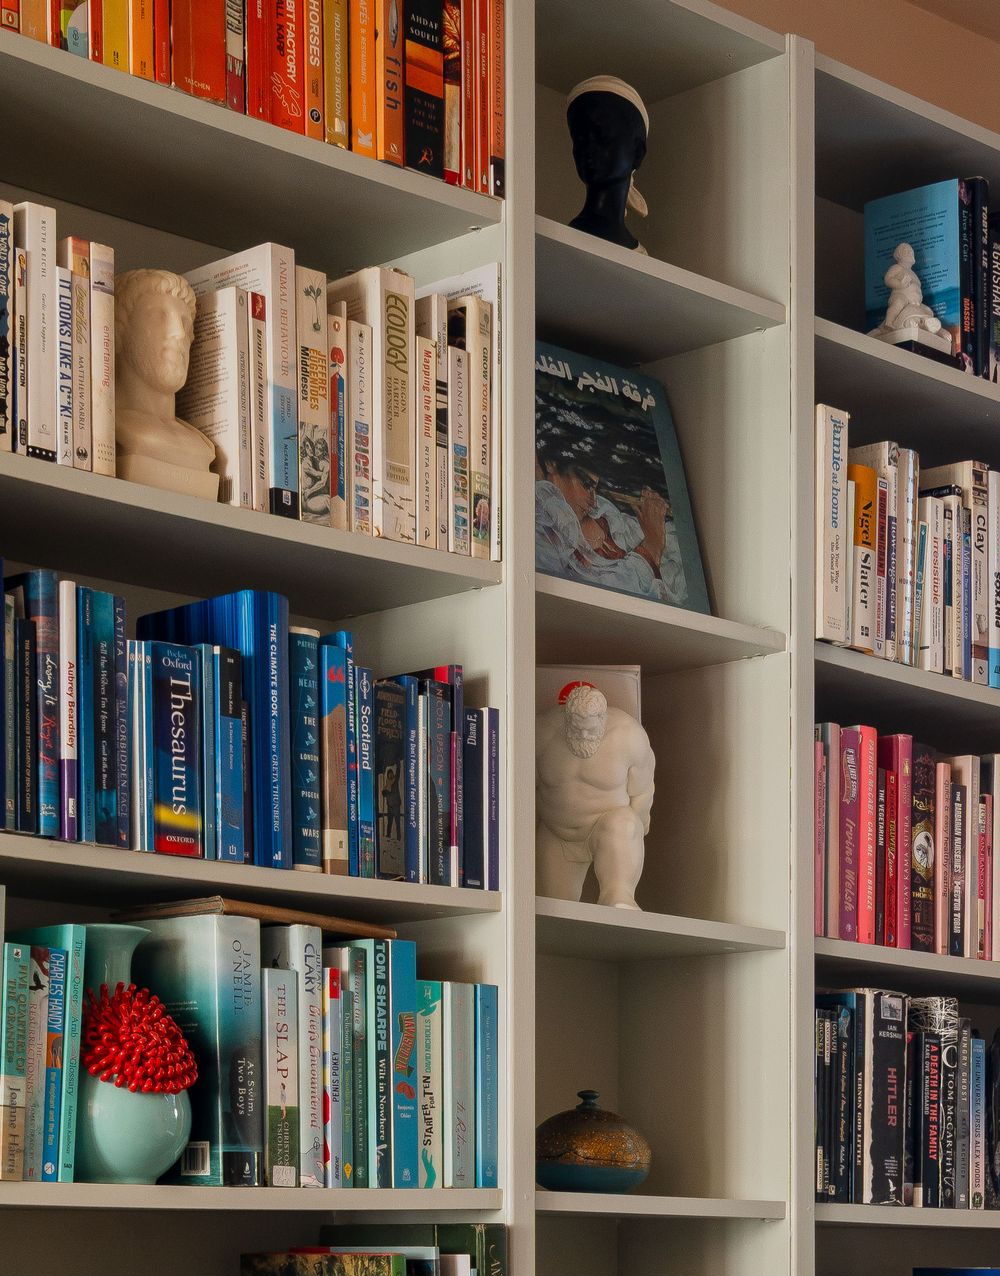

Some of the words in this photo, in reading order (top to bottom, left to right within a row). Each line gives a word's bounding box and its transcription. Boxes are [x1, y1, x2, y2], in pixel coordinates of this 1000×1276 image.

[309, 0, 320, 67] HORSES
[411, 13, 439, 30] AHDAF
[286, 23, 296, 82] FACTORY
[184, 76, 211, 92] TASCHEN
[386, 56, 401, 111] fish
[59, 279, 71, 290] IT
[60, 295, 71, 336] LOOKS
[386, 295, 408, 374] ECOLOGY
[60, 341, 72, 368] LIKE
[103, 326, 111, 387] entertaining
[281, 308, 289, 376] BEHAVIOUR
[61, 372, 72, 380] A
[301, 346, 310, 400] Middlesex
[310, 349, 318, 410] EUGENIDES
[318, 351, 327, 399] JEFFREY
[423, 350, 431, 395] Mapping
[424, 398, 432, 411] the
[424, 414, 432, 438] Mind
[830, 416, 843, 471] jamie
[832, 473, 839, 484] at
[831, 488, 840, 528] home
[859, 501, 872, 546] Nigel
[975, 515, 987, 553] Clay
[859, 552, 872, 609] Slater
[66, 662, 75, 697] Aubrey
[162, 656, 192, 670] Oxford
[67, 701, 75, 748] Beardsley
[436, 689, 444, 728] NICOLA
[170, 673, 192, 815] Thesaurus
[361, 705, 371, 769] Scotland
[436, 733, 444, 771] UPSON
[166, 835, 194, 843] OXFORD
[49, 954, 64, 995] CHARLES
[232, 940, 242, 1016] O'NEILL
[243, 951, 252, 1006] JAMIE
[376, 943, 386, 979] TOM
[48, 998, 62, 1030] HANDY
[277, 984, 286, 1016] THE
[377, 991, 386, 1051] SHARPE
[277, 1022, 289, 1079] SLAP
[931, 1045, 938, 1053] A
[237, 1058, 246, 1083] Two
[248, 1061, 255, 1077] At
[380, 1082, 386, 1092] in
[930, 1055, 938, 1087] DEATH
[6, 1087, 20, 1128] Joanne
[238, 1088, 247, 1115] Boys
[248, 1081, 256, 1116] Swim,
[887, 1067, 897, 1126] HITLER
[930, 1090, 937, 1100] IN
[8, 1133, 19, 1174] Harris
[929, 1124, 937, 1160] FAMILY
